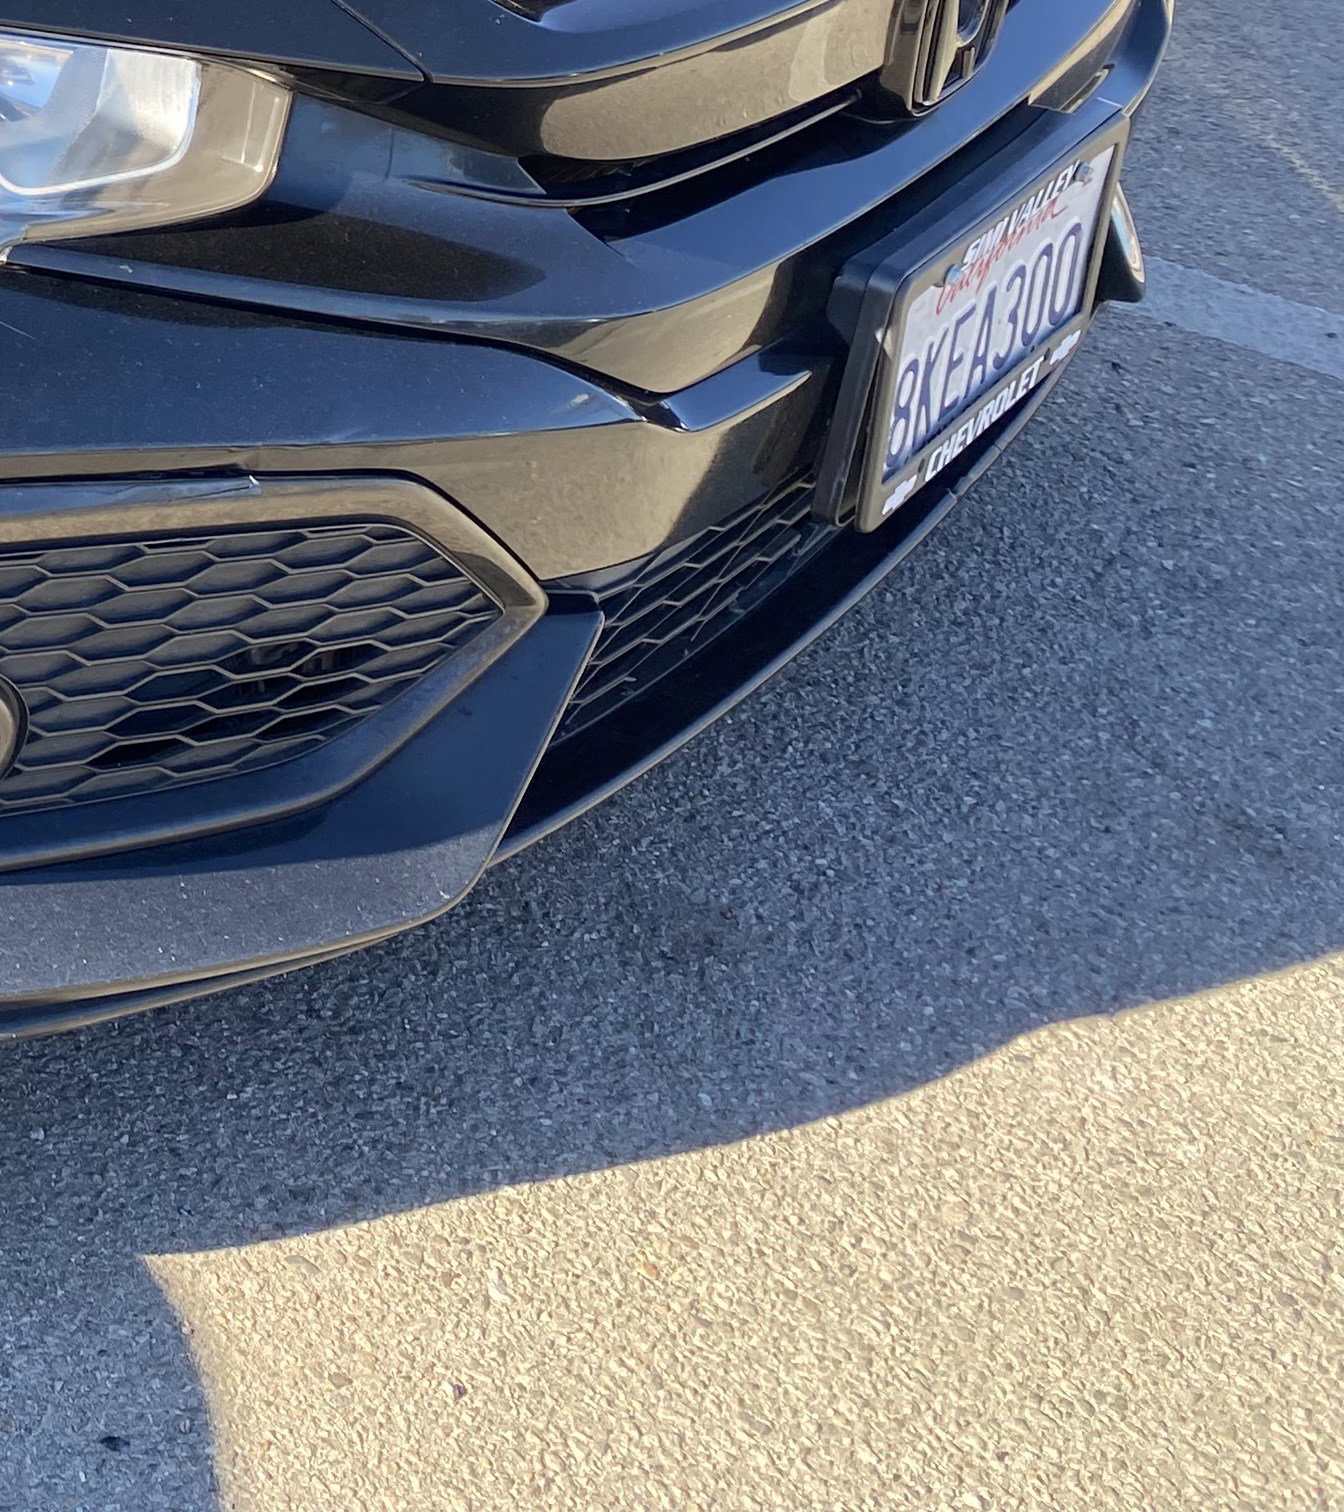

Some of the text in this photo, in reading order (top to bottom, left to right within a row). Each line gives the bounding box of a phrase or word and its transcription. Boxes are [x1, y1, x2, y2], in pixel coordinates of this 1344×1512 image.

[960, 159, 1081, 271] SIMI VALLEY
[886, 221, 1083, 468] 8KEA300
[924, 355, 1046, 483] CHEVROLET
